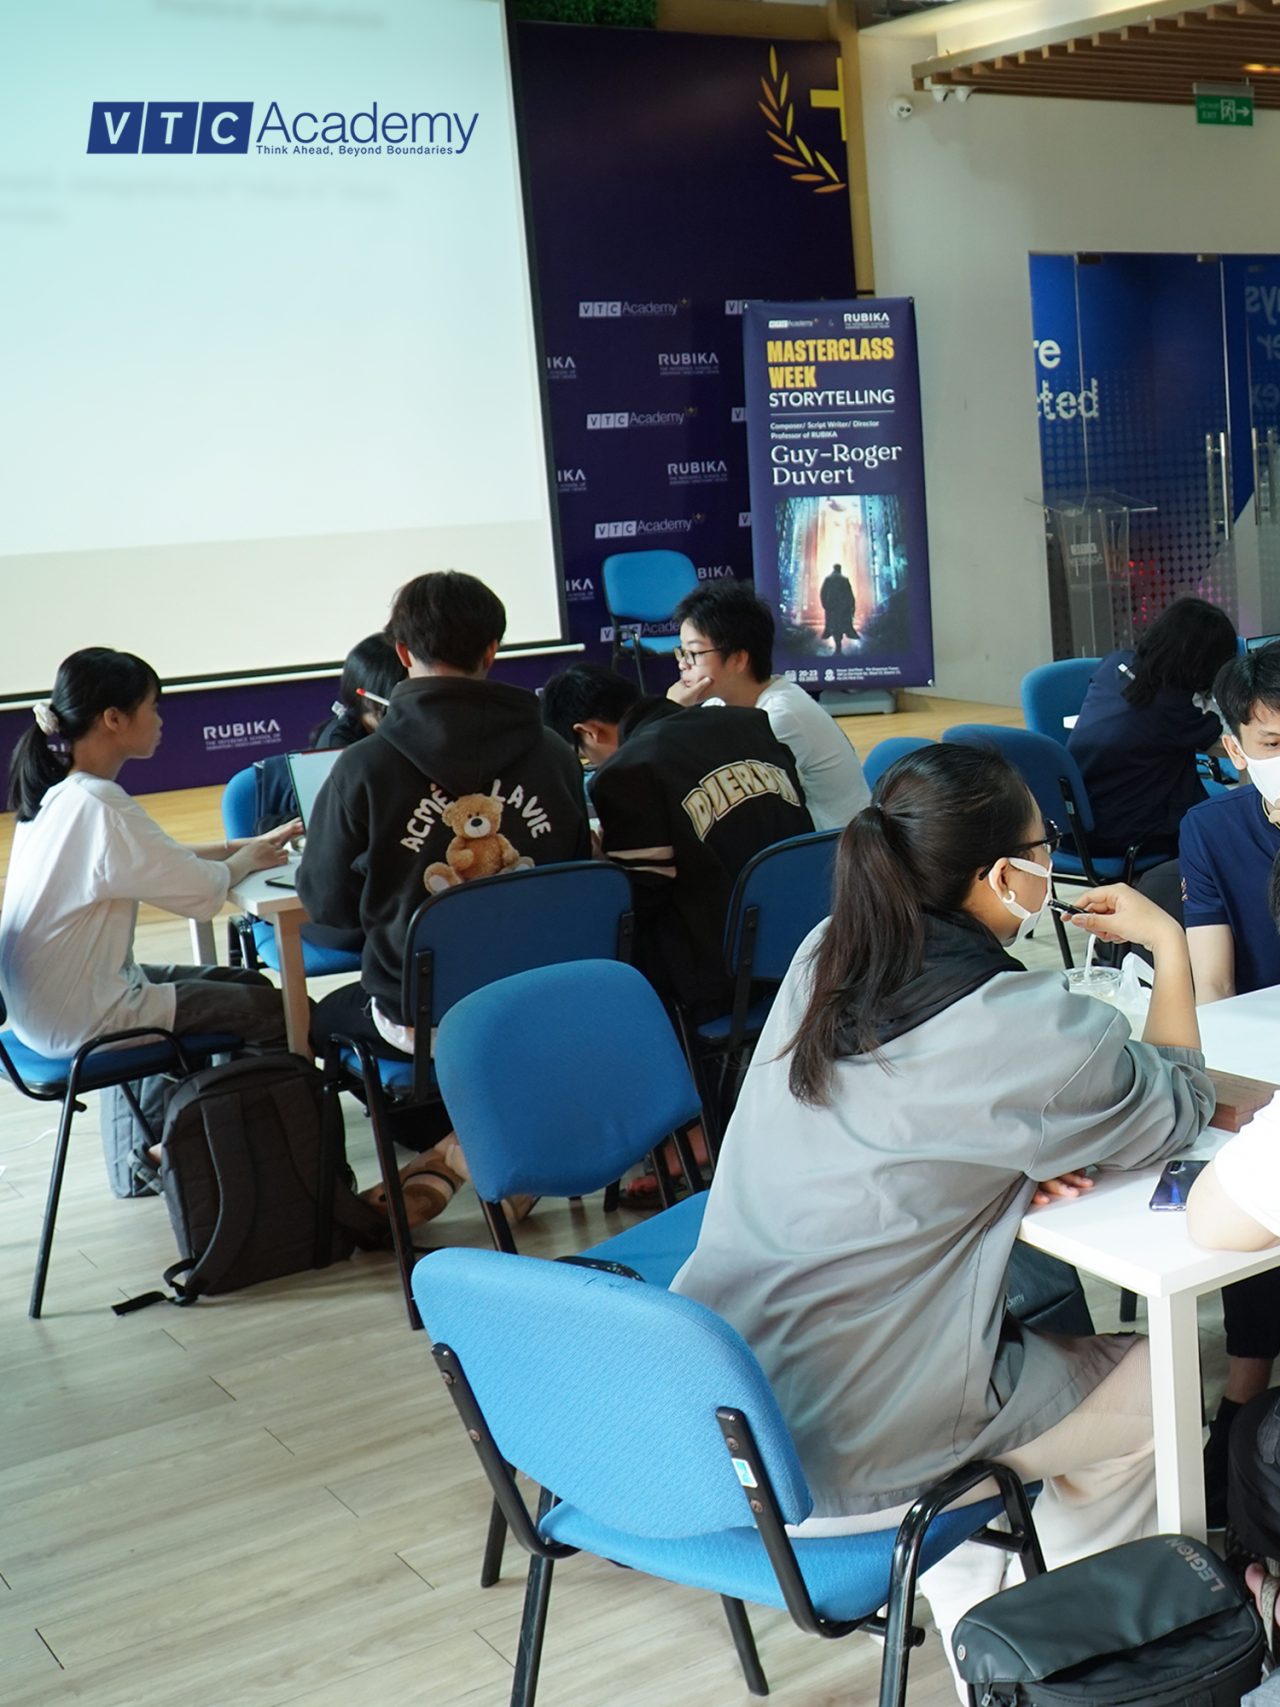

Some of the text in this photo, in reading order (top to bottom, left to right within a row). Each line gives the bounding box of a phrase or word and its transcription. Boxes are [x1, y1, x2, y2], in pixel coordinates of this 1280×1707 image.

[581, 301, 678, 316] VTC Academy
[843, 312, 890, 323] RUBIKA
[767, 337, 895, 363] MASTERCLASS
[547, 356, 576, 369] IKA
[658, 352, 719, 366] RUBIKA
[768, 365, 817, 389] WEEK
[769, 389, 896, 408] STORYTELLING
[1037, 377, 1099, 420] ted
[589, 411, 685, 428] VTC Academy
[852, 420, 880, 428] Director
[770, 430, 838, 440] Professor of RUBIKA
[668, 460, 728, 475] RUBIKA
[557, 469, 586, 482] IKA
[773, 466, 855, 485] Duvert
[597, 518, 693, 537] VTC Academy
[697, 565, 734, 580] BIKA
[565, 578, 594, 591] IKA
[203, 719, 281, 740] RUBIKA
[1165, 1537, 1226, 1592] LEGION
